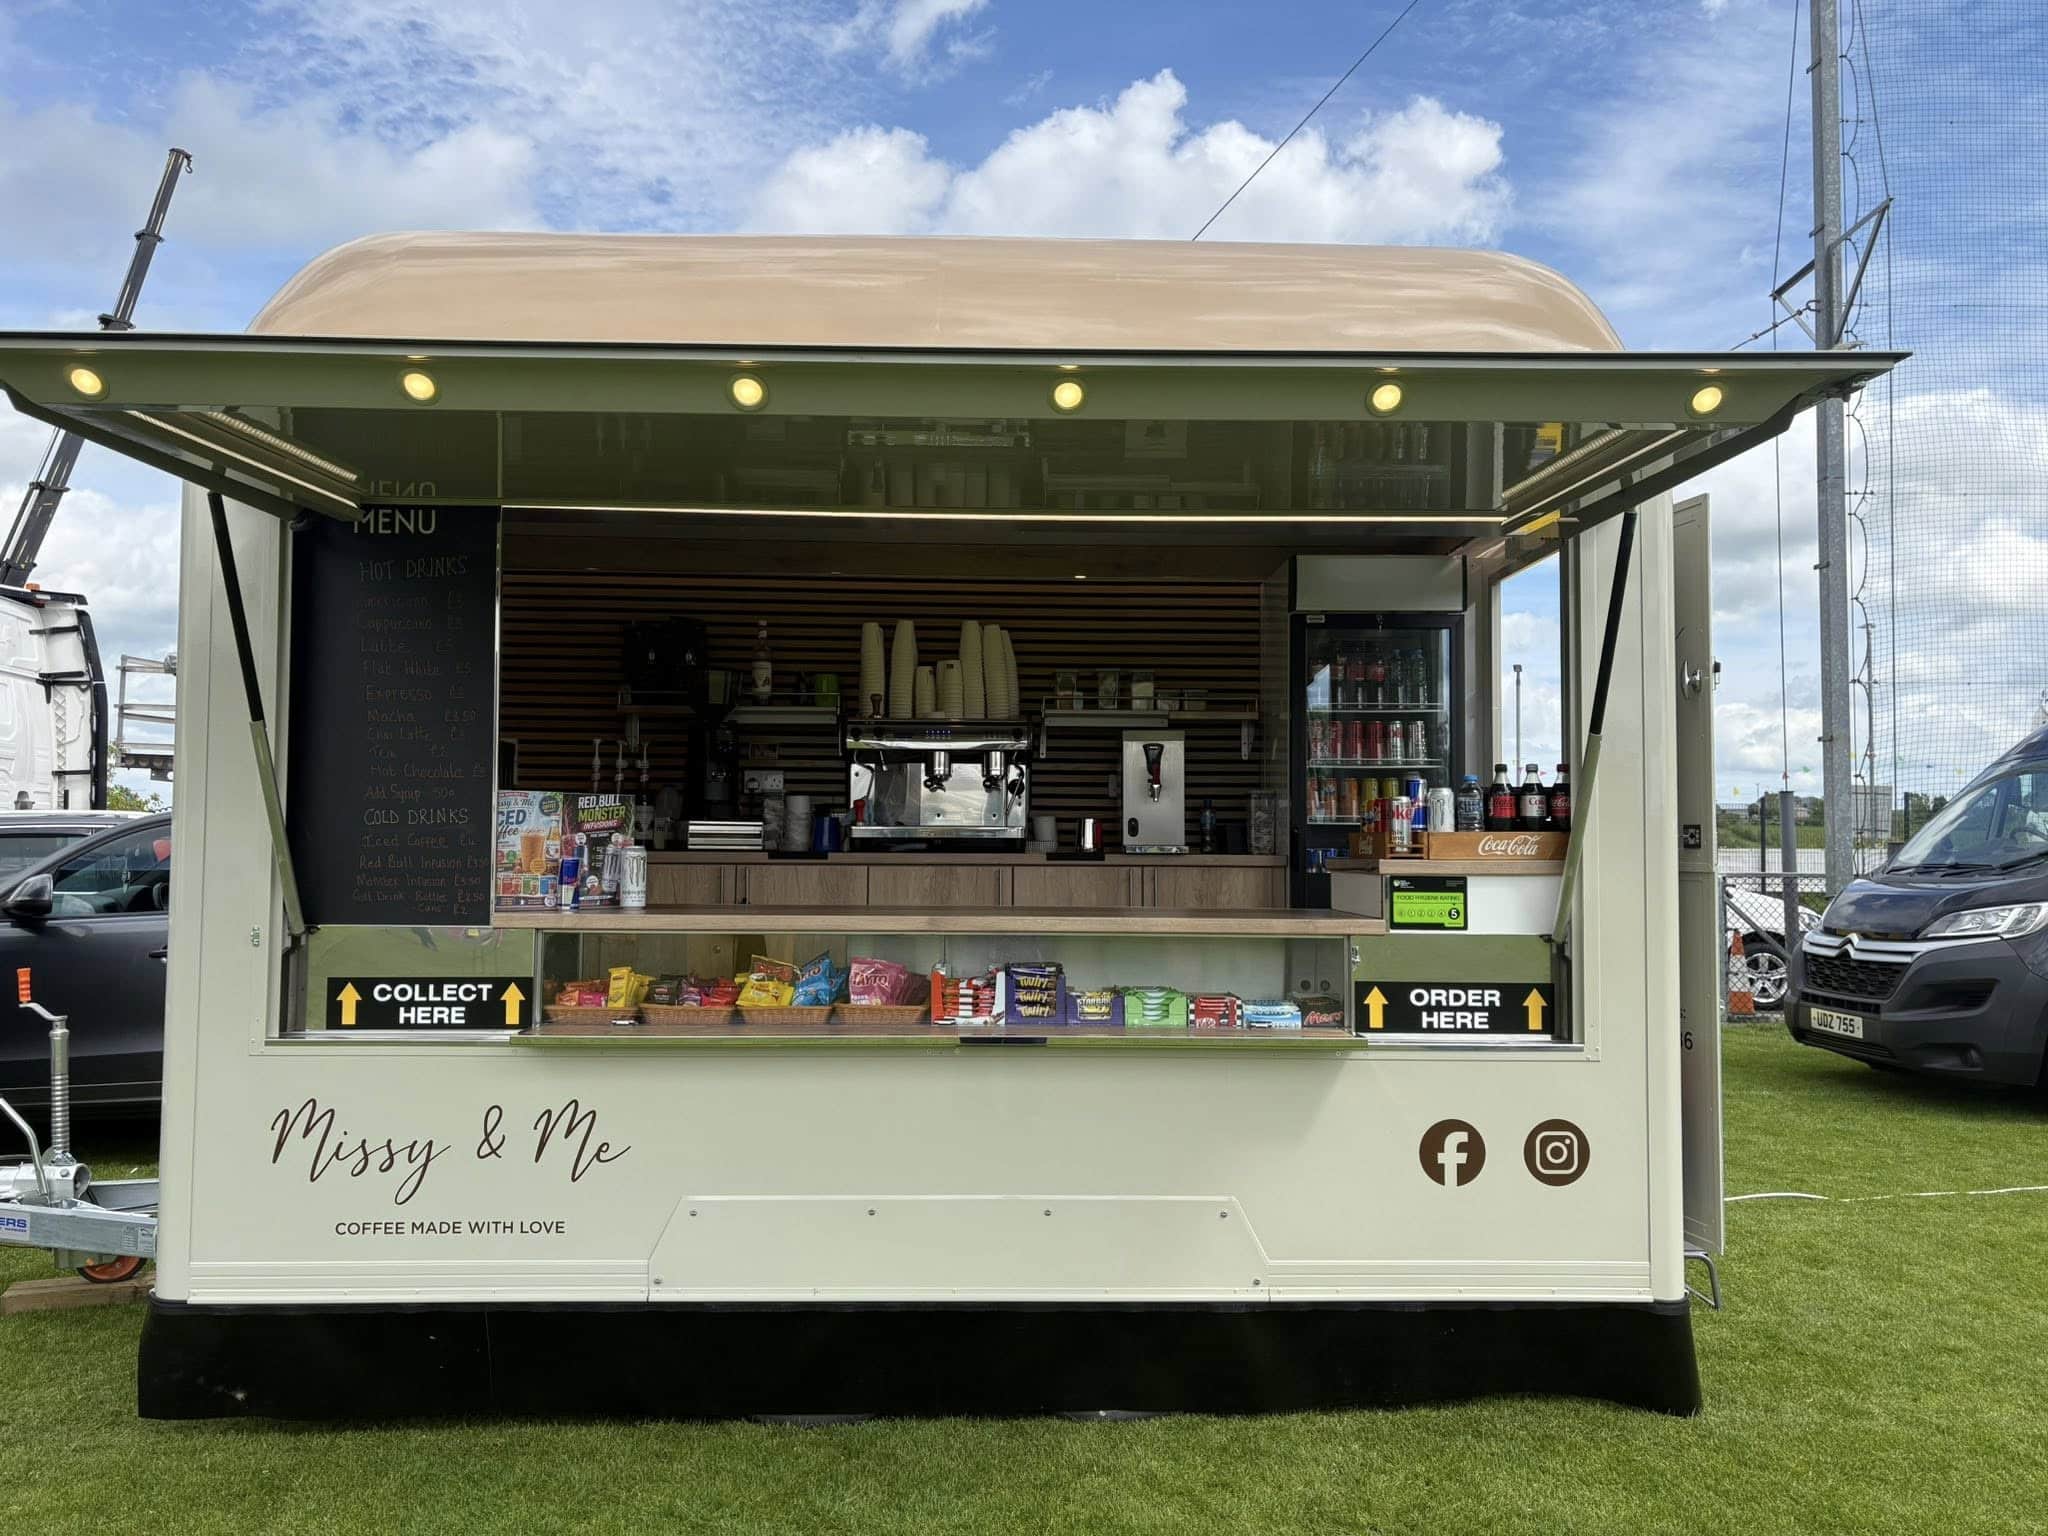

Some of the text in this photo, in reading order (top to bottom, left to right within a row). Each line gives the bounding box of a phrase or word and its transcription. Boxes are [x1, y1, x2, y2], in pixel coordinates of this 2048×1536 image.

[354, 509, 436, 534] MENU
[360, 556, 468, 583] HOT DRINKS
[368, 708, 416, 722] Mocha
[578, 793, 621, 809] RED BULL
[364, 808, 468, 825] COLD DRINKS
[498, 809, 527, 825] CED
[577, 805, 626, 822] MONSTER
[1478, 834, 1542, 856] Coca-Cola
[360, 856, 381, 869] Red
[1450, 909, 1458, 919] 5
[1018, 975, 1049, 989] Twirl
[373, 984, 493, 1001] COLLECT
[1018, 990, 1048, 1003] Twirl
[1409, 988, 1501, 1007] ORDER
[399, 1007, 466, 1024] HERE
[1019, 1005, 1050, 1017] Twirl
[1422, 1011, 1489, 1029] HERE
[1817, 1011, 1855, 1034] UDZ 755
[1680, 1031, 1693, 1050] 6
[271, 1098, 632, 1205] Missy & Me
[335, 1221, 565, 1235] COFFEE MADE WITH LOVE
